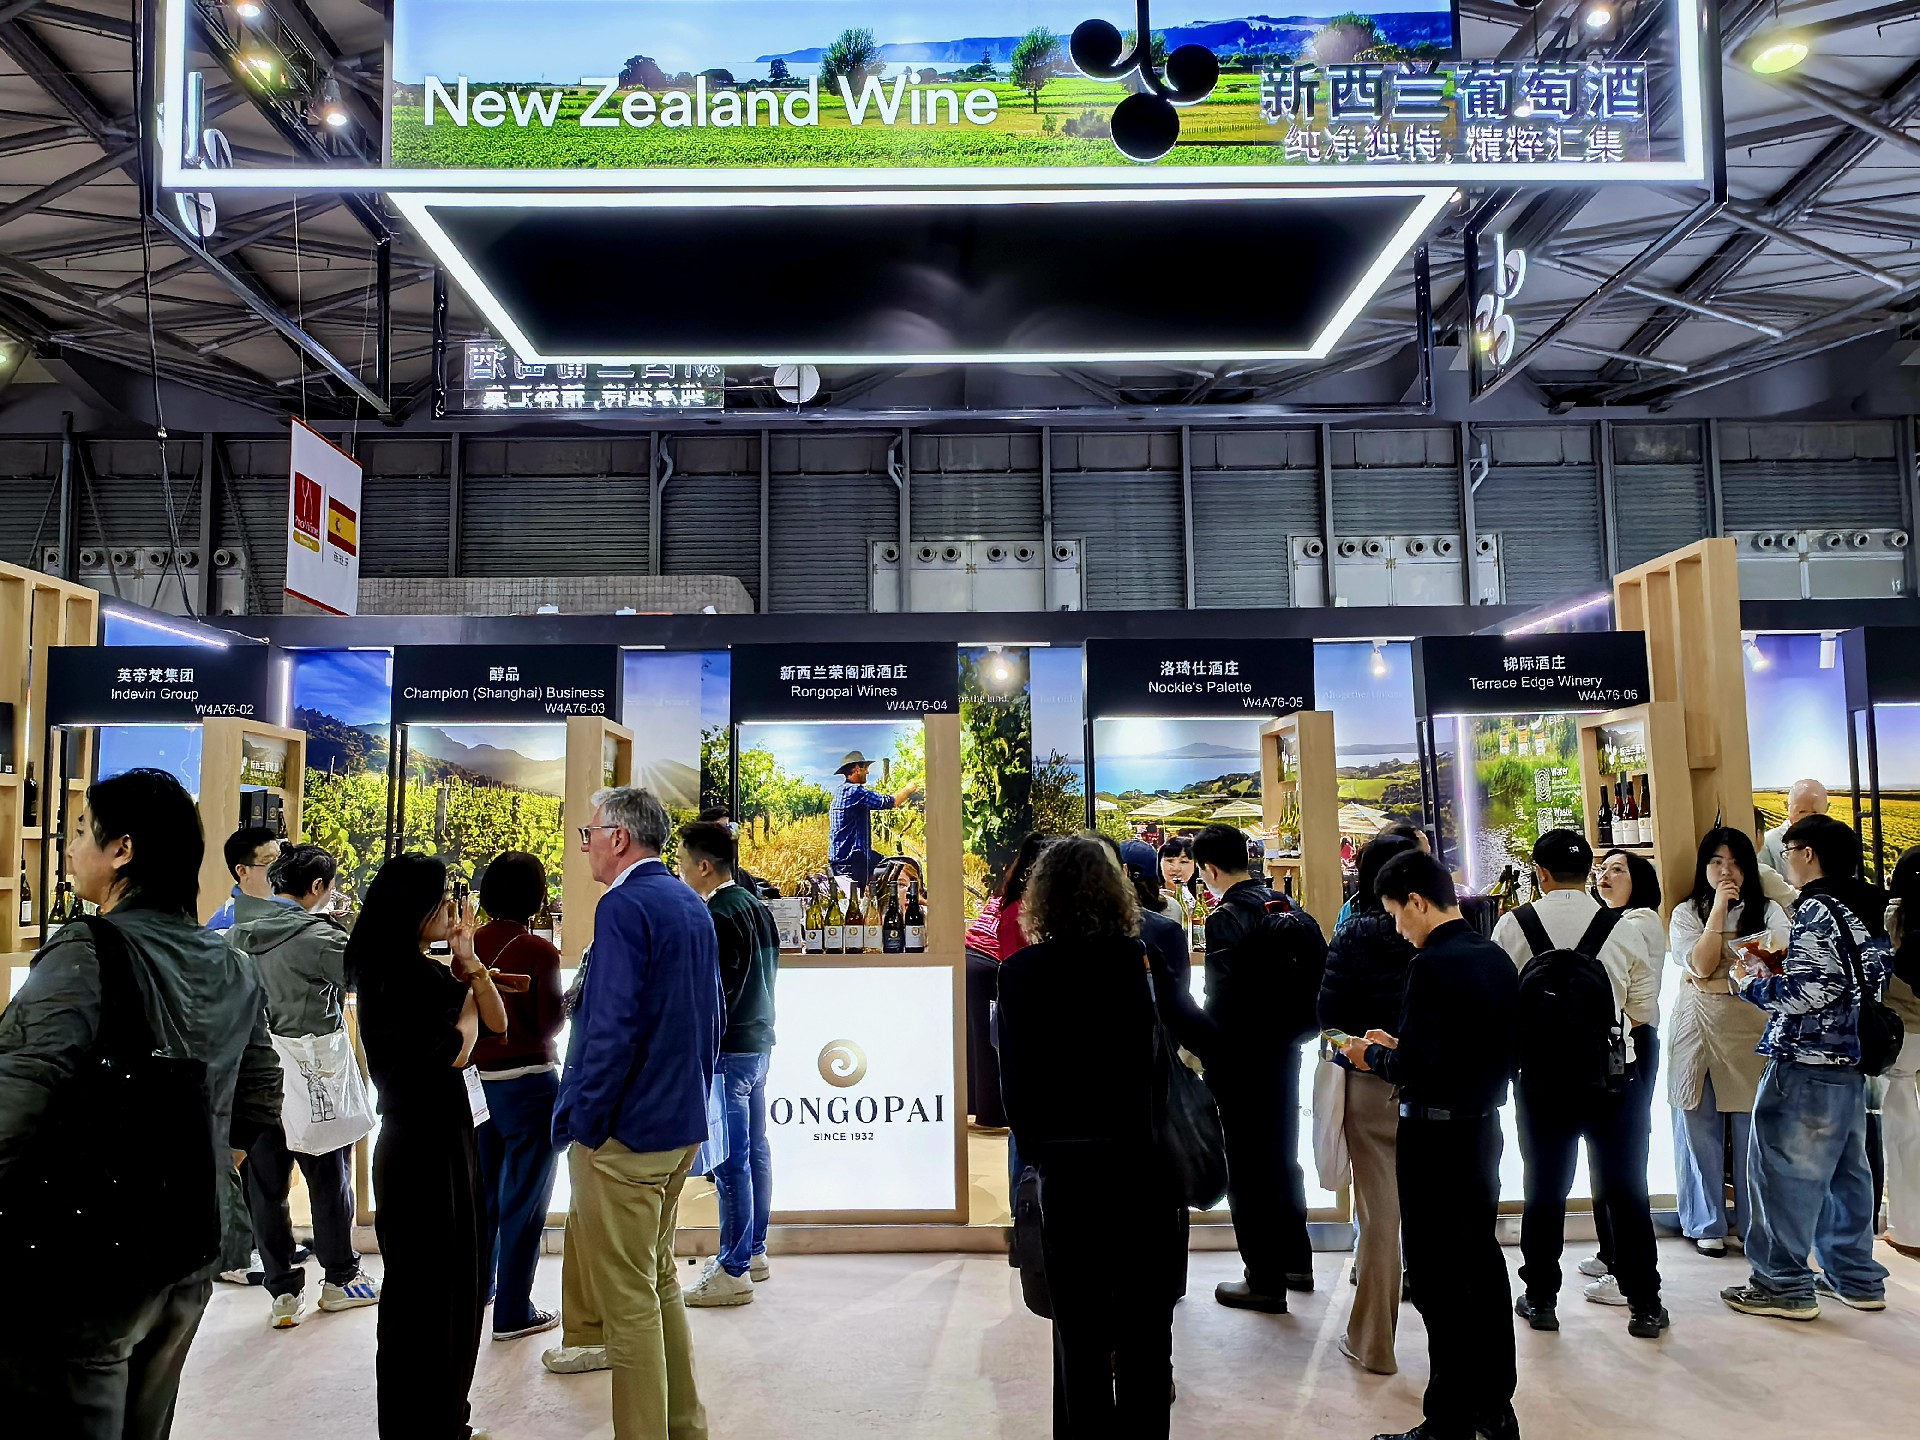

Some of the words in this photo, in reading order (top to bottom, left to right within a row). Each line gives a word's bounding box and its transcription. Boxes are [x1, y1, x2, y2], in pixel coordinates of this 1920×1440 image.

[1260, 61, 1646, 122] 新西兰葡萄酒
[424, 74, 562, 127] New
[579, 74, 819, 127] Zealand
[838, 72, 999, 126] Wine
[117, 667, 194, 683] 英帝梵集团
[489, 666, 520, 682] 醇品
[780, 664, 908, 680] 新西兰荣阁派酒庄
[1148, 681, 1203, 693] Nockie's
[1207, 682, 1252, 693] Palette
[1469, 677, 1518, 690] Terrace
[1521, 677, 1555, 690] Edge
[1558, 675, 1603, 688] Winery
[111, 688, 156, 700] Indevin
[160, 688, 199, 702] Group
[403, 687, 469, 701] Champion
[473, 687, 543, 702] (Shanghai)
[546, 686, 605, 698] Business
[791, 685, 853, 700] Rongopai
[857, 685, 898, 697] Wines
[1577, 689, 1639, 701] W4A76-06
[194, 703, 254, 715] W4A76-02
[544, 702, 606, 714] W4A76-03
[886, 700, 948, 711] W4A76-04
[1242, 697, 1304, 708] W4A76-05
[770, 1094, 944, 1125] ONGOPAI
[813, 1132, 847, 1141] SINCE
[850, 1131, 874, 1141] 1932
